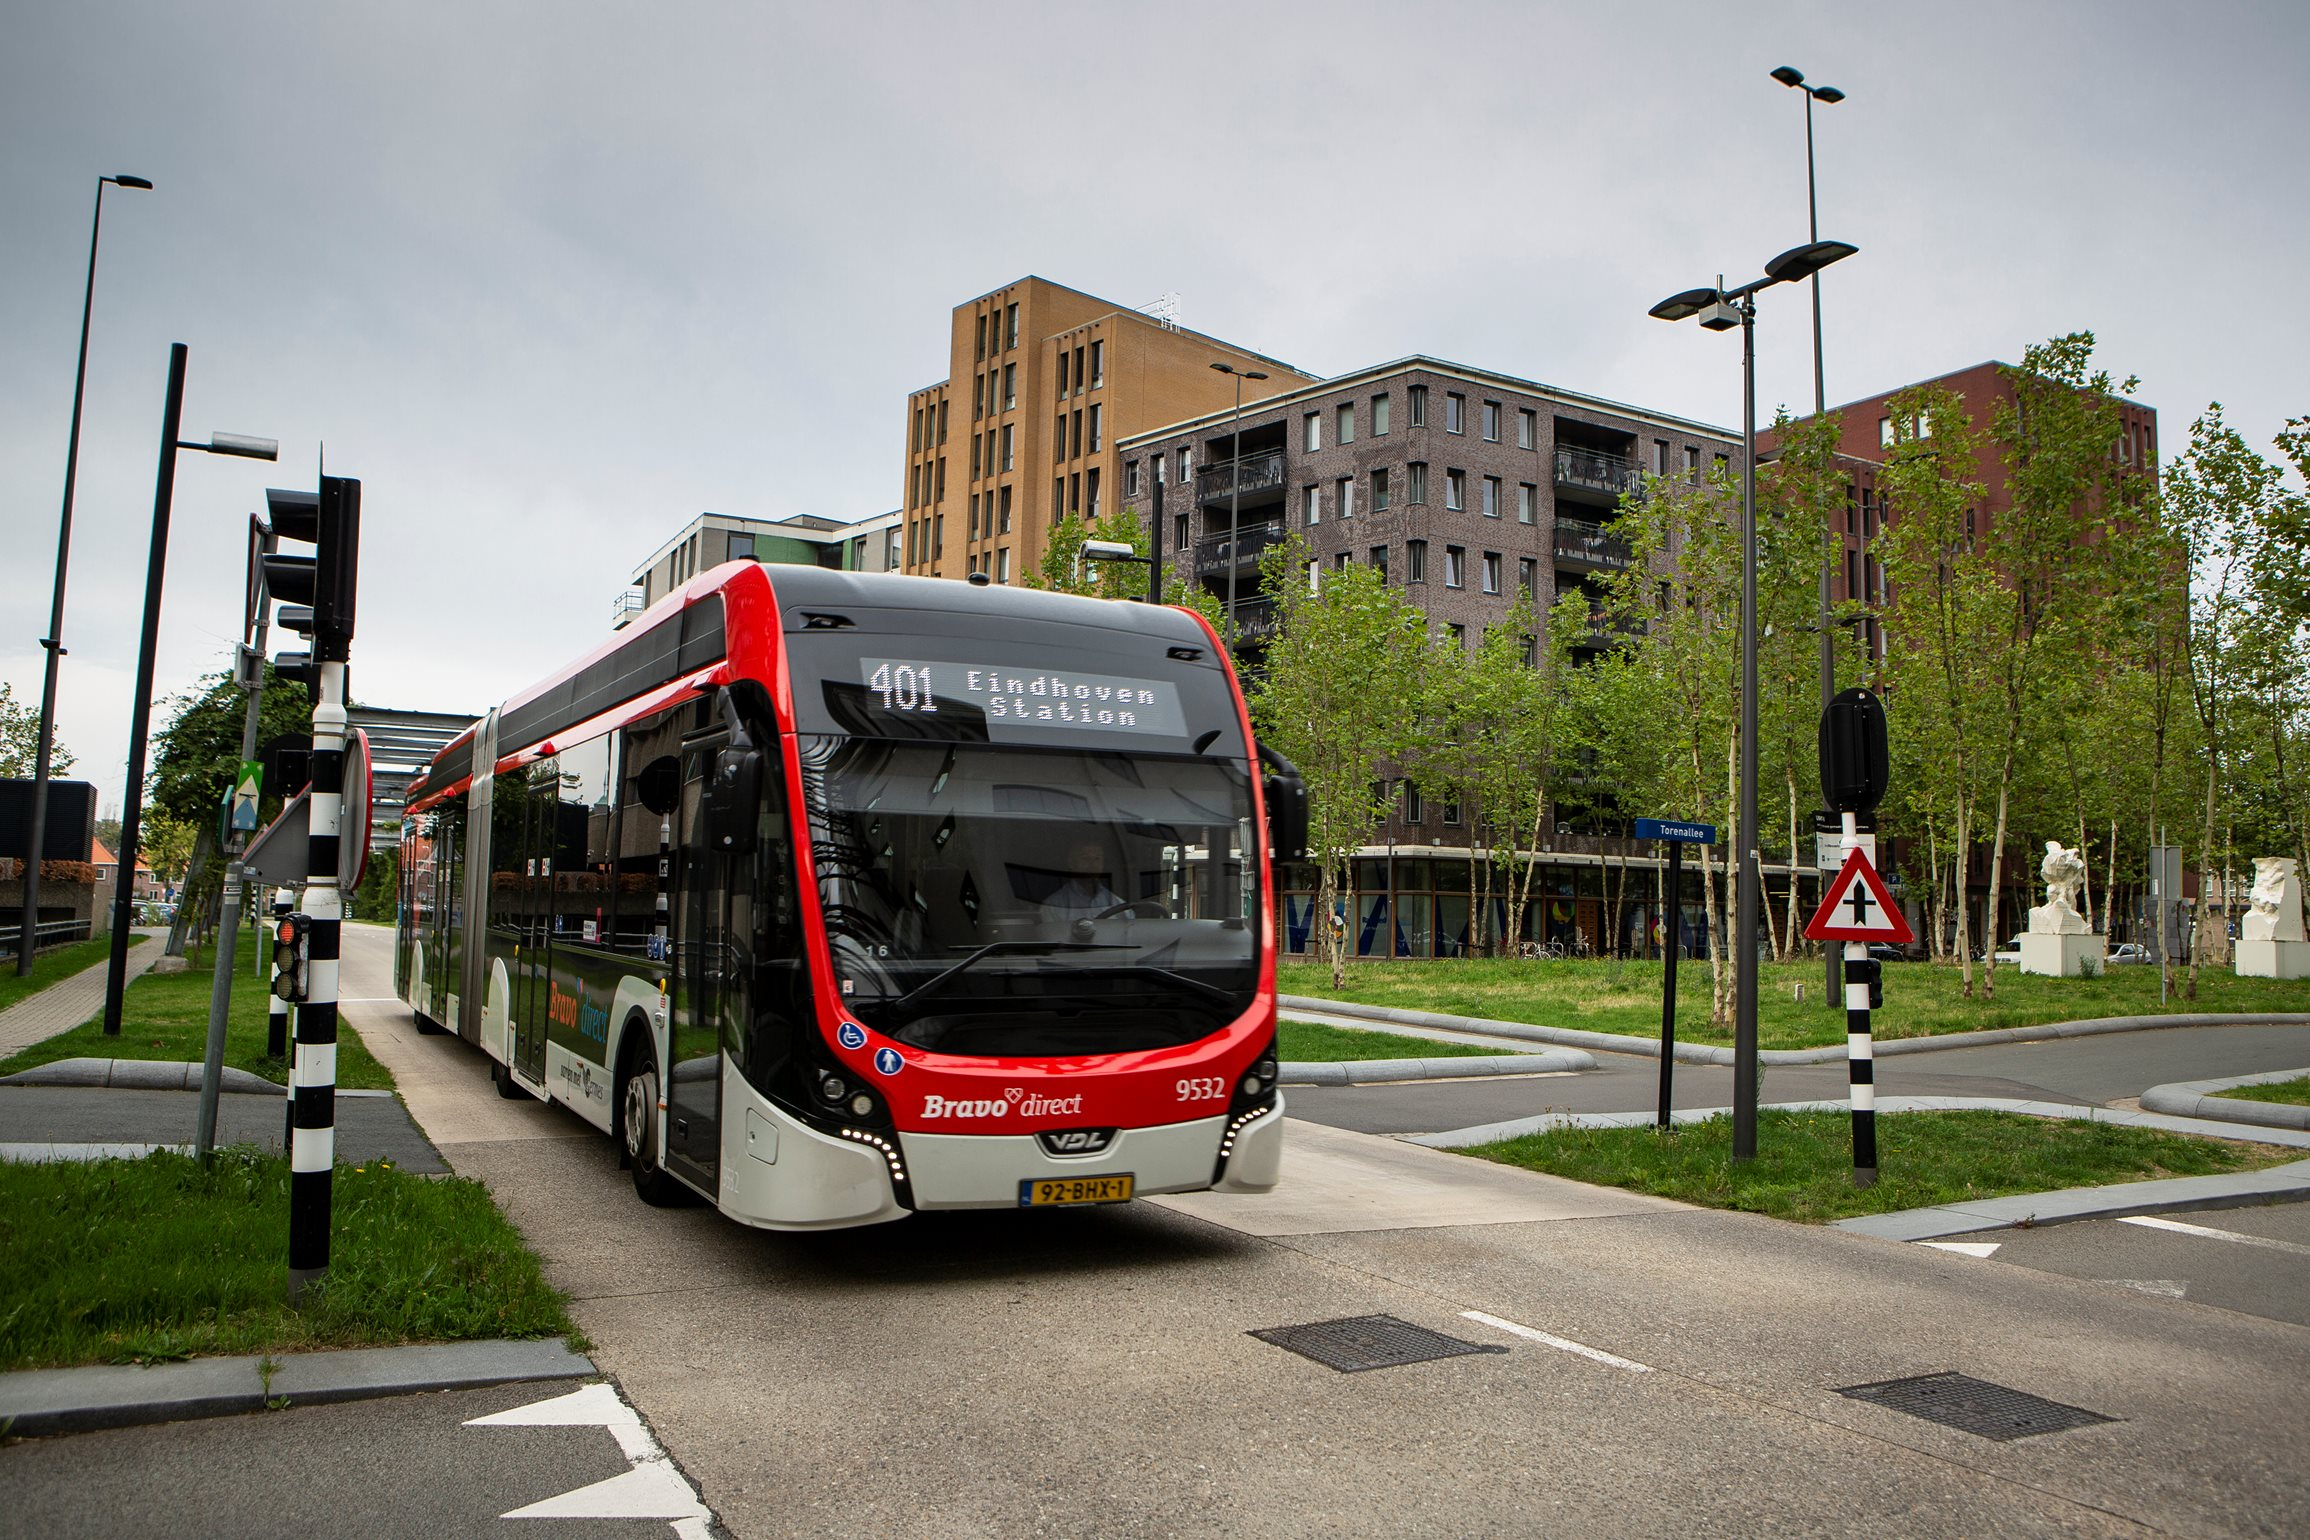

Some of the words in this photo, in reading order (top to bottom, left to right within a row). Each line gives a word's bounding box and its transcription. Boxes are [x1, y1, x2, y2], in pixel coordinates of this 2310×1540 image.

[870, 664, 937, 712] 401
[967, 670, 1154, 705] Eindhoven
[990, 697, 1137, 727] Station
[1660, 824, 1704, 839] Torenallee
[549, 981, 577, 1028] Bravo
[581, 992, 608, 1043] direct
[1175, 1076, 1226, 1102] 9532
[920, 1094, 1008, 1119] Bravo
[1019, 1093, 1083, 1117] direct
[1049, 1132, 1105, 1150] VDL
[1041, 1180, 1124, 1201] 92-BHX-1
